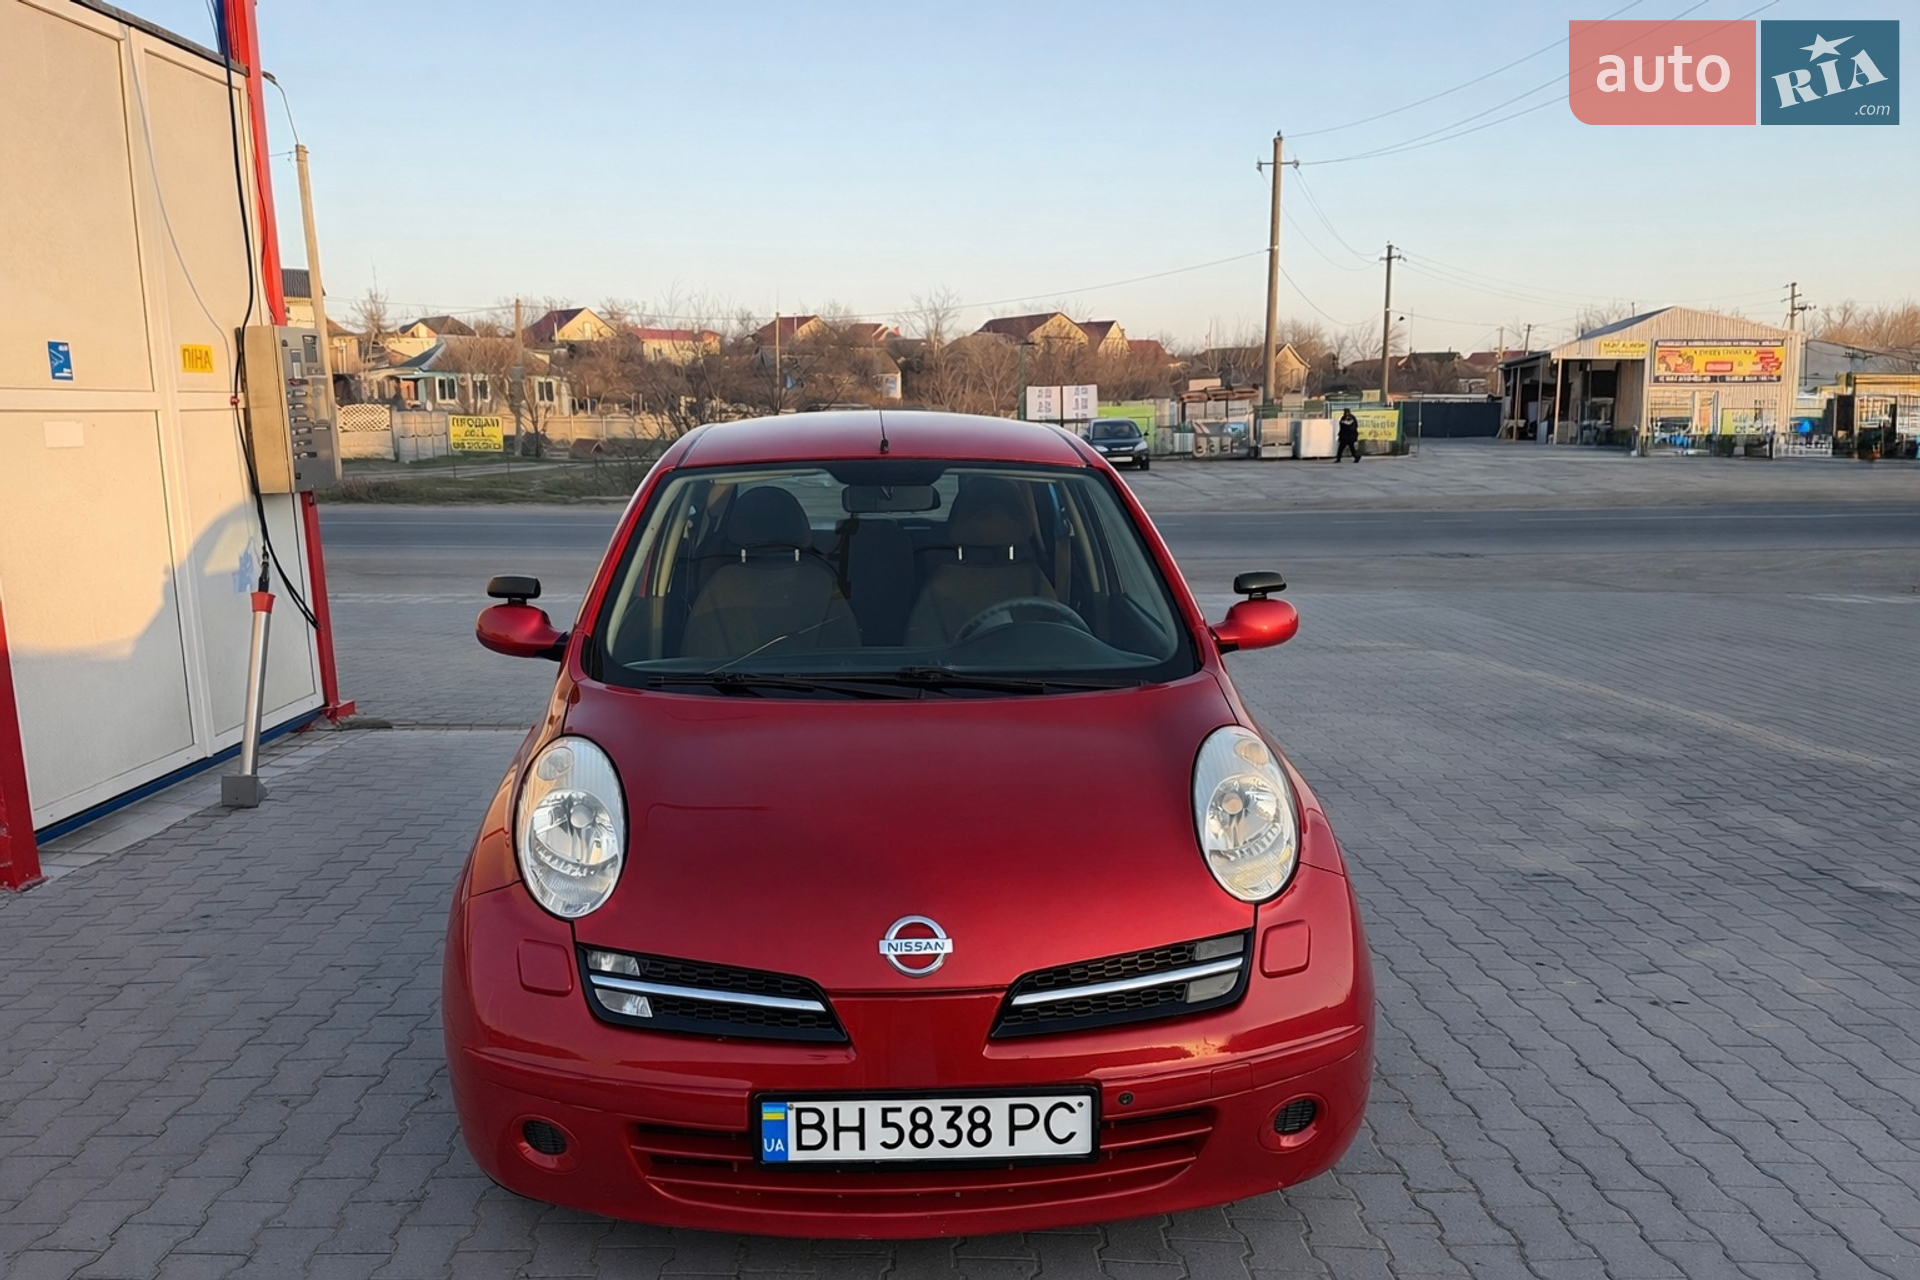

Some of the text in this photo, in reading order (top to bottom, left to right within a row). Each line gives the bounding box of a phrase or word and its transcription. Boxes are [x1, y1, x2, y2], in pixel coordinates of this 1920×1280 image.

[182, 348, 213, 369] ПІНА
[887, 941, 945, 953] NISSAN
[795, 1101, 1078, 1151] BH 5838 PC
[763, 1138, 785, 1152] UA
